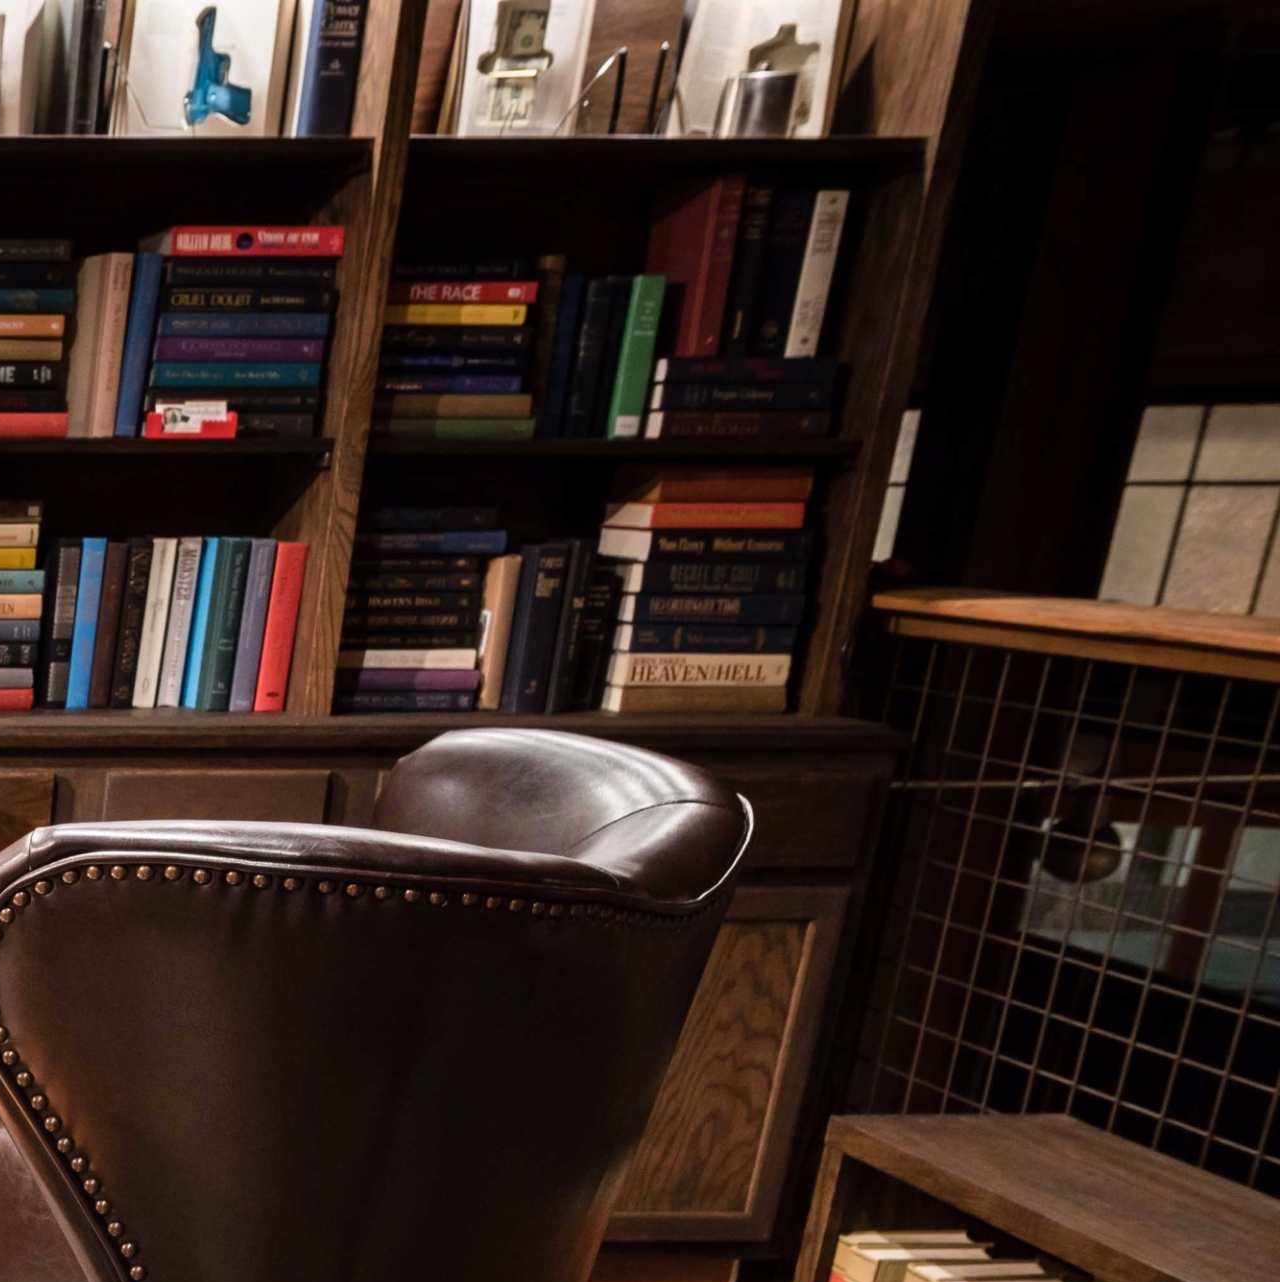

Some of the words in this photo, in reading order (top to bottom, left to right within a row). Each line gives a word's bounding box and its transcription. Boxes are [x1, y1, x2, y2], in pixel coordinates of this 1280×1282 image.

[171, 294, 206, 305] CRUEL
[210, 294, 252, 305] DOUBT
[409, 285, 438, 300] THE
[442, 285, 482, 300] RACE
[178, 548, 198, 600] MONSTER
[671, 562, 712, 581] DEGREE
[732, 563, 760, 581] GUILT
[630, 663, 708, 682] HEAVEN
[715, 662, 768, 682] HELL
